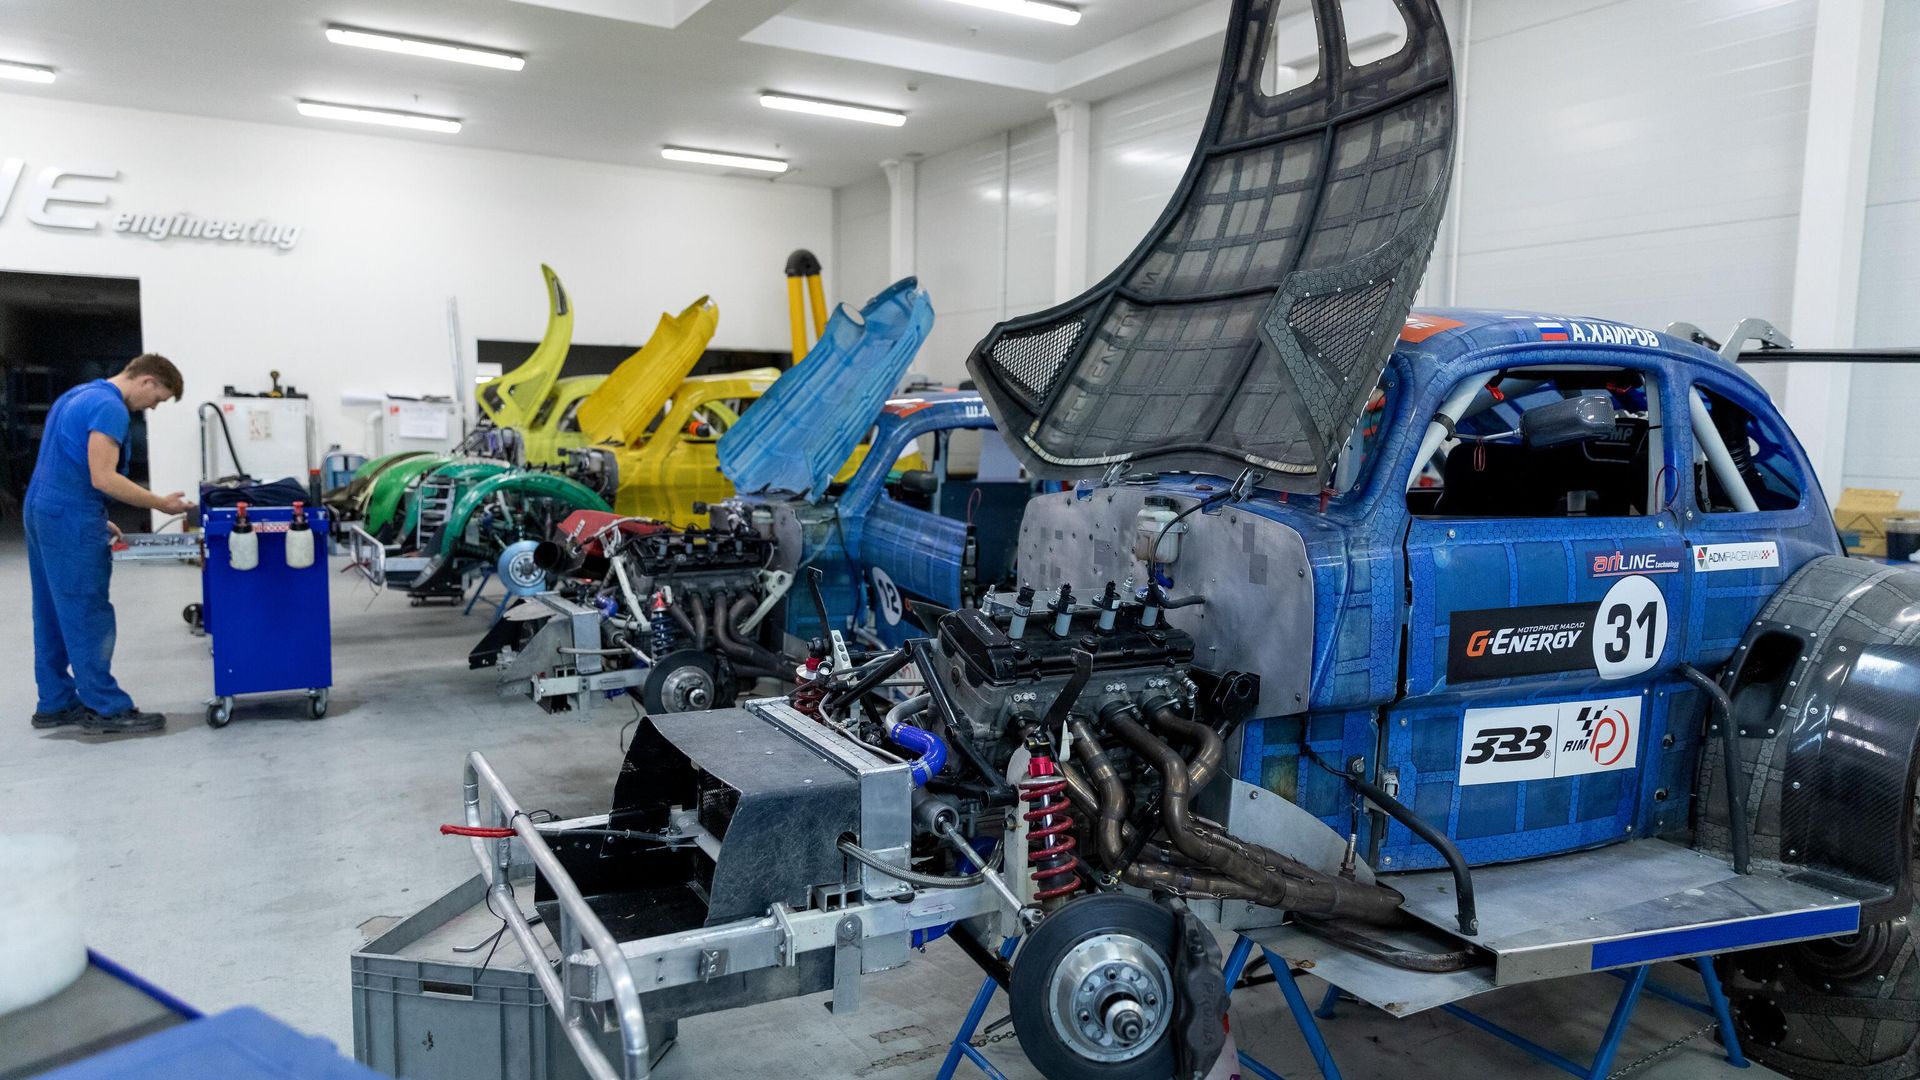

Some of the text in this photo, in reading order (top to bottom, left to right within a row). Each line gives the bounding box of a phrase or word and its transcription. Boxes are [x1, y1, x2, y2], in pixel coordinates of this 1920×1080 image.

[113, 212, 300, 250] engineering
[1593, 551, 1679, 573] artLINE technology
[878, 579, 900, 615] 12
[1517, 623, 1559, 633] МОТОРНОЕ
[1604, 601, 1658, 663] 31
[1562, 739, 1589, 752] RIM
